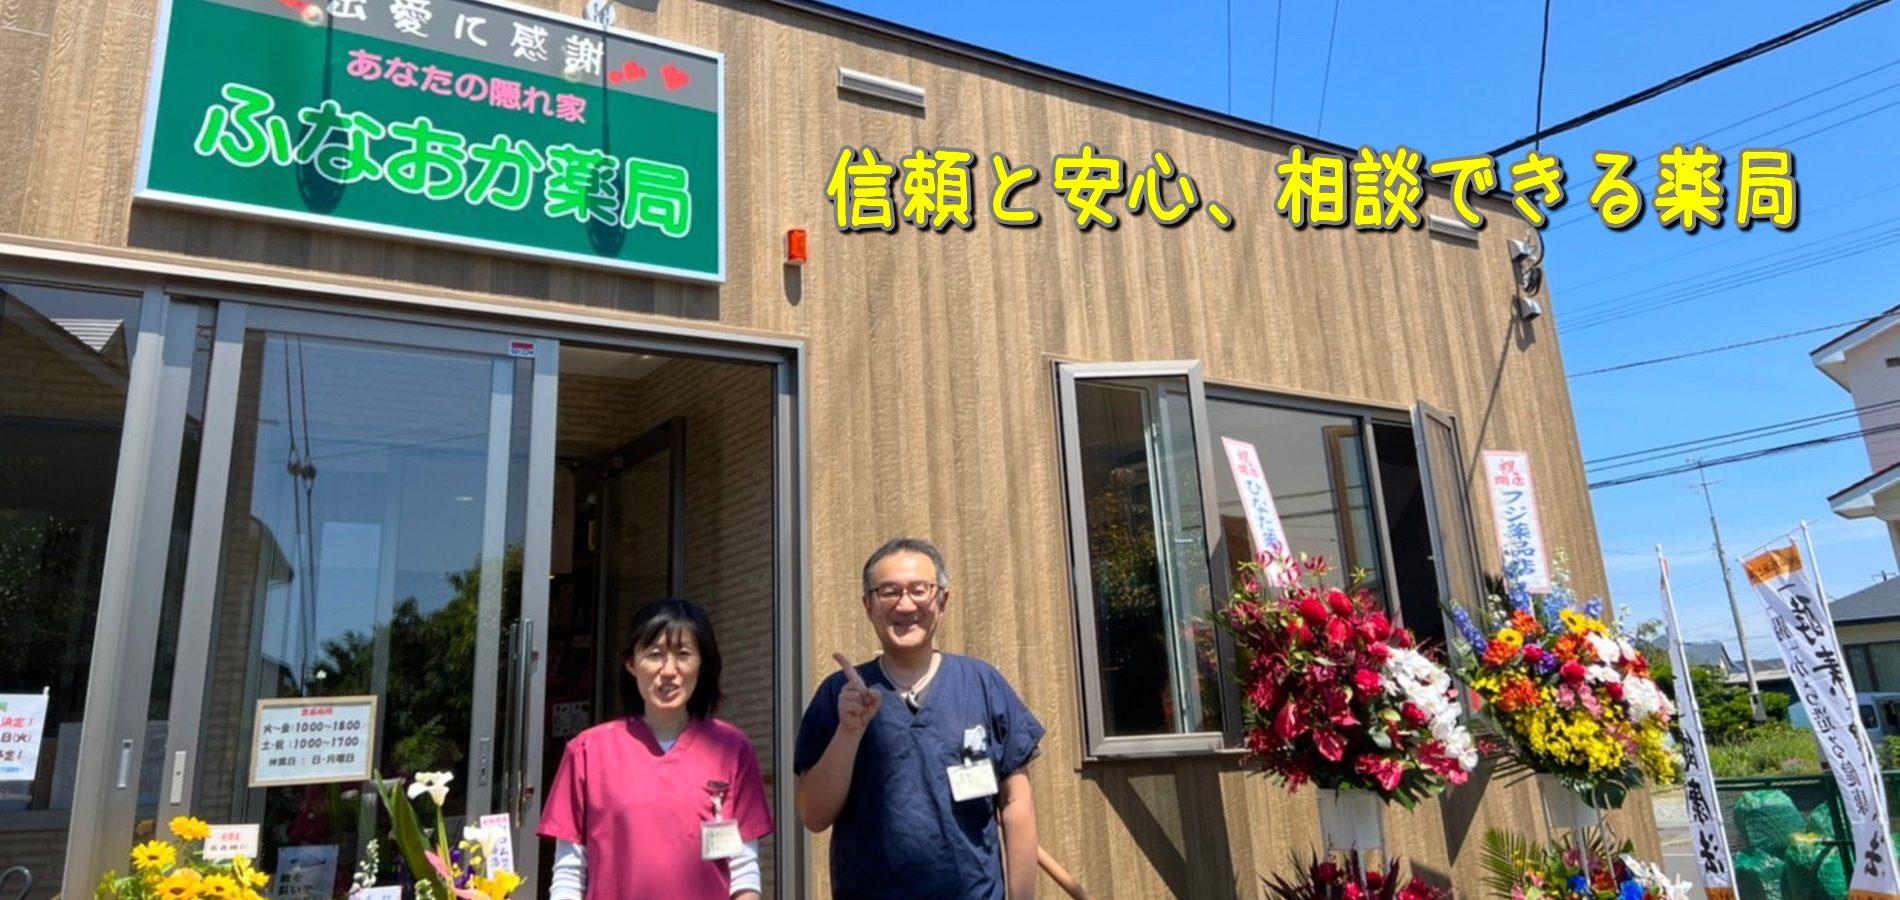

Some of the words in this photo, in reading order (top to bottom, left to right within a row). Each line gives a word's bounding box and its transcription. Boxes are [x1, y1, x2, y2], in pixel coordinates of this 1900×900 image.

[346, 49, 588, 124] あなたの隠れ家
[194, 82, 693, 238] ふなおか薬局
[1494, 473, 1524, 486] 開店
[1498, 459, 1515, 474] 祝
